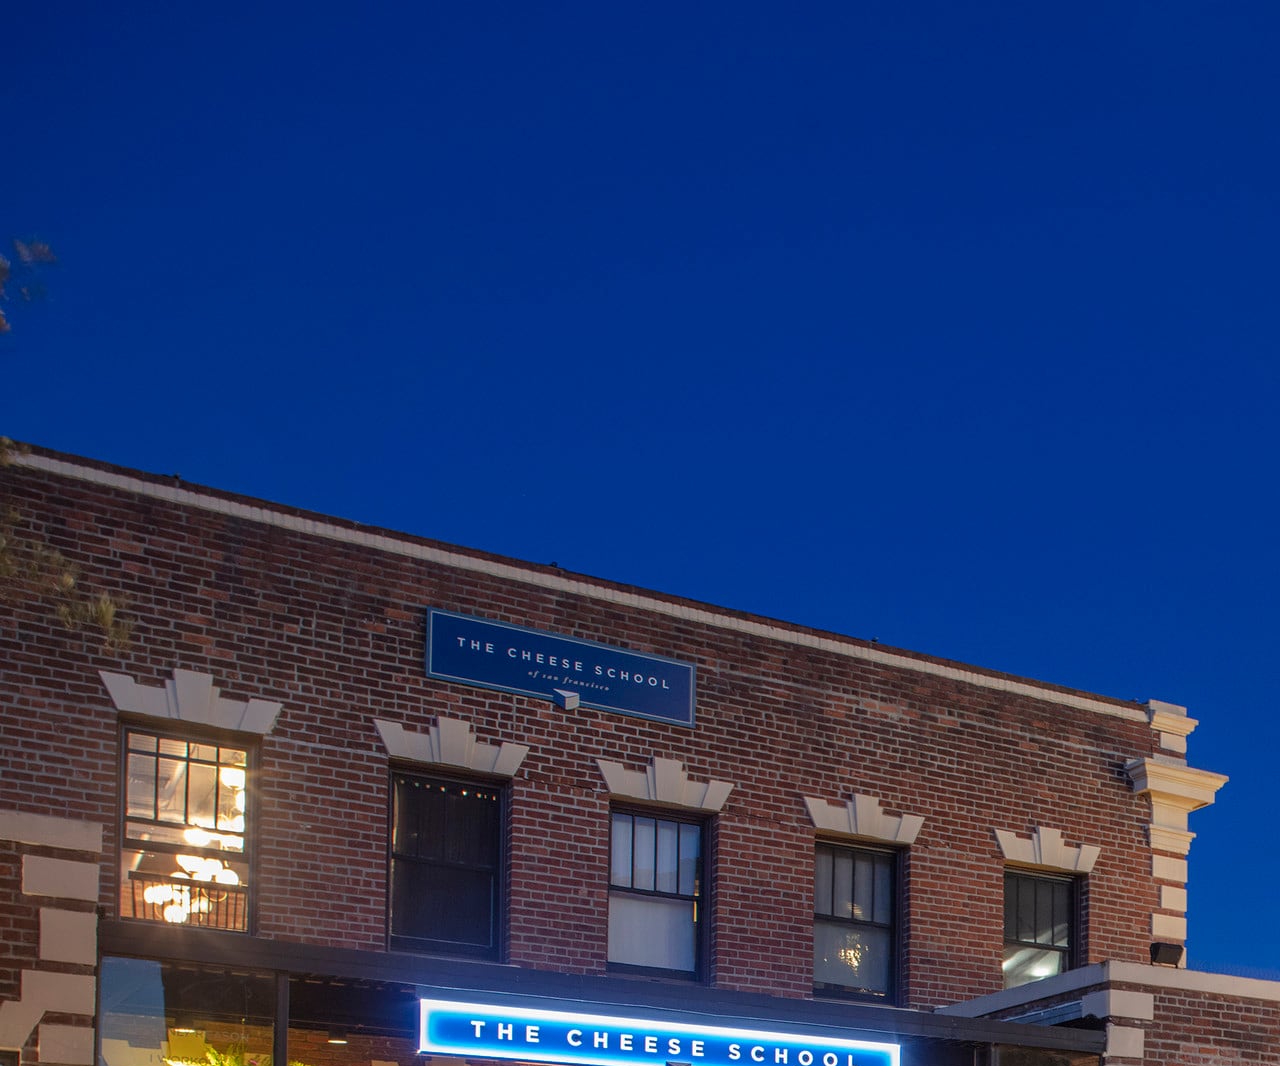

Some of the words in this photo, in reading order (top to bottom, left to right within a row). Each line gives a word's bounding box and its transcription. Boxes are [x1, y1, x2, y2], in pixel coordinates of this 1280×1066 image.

[456, 636, 495, 653] THE
[507, 647, 584, 672] CHEESE
[594, 665, 670, 690] SCHOOL
[527, 670, 540, 679] of
[561, 676, 610, 692] francisco
[470, 1019, 541, 1044] THE
[566, 1028, 705, 1058] CHEESE
